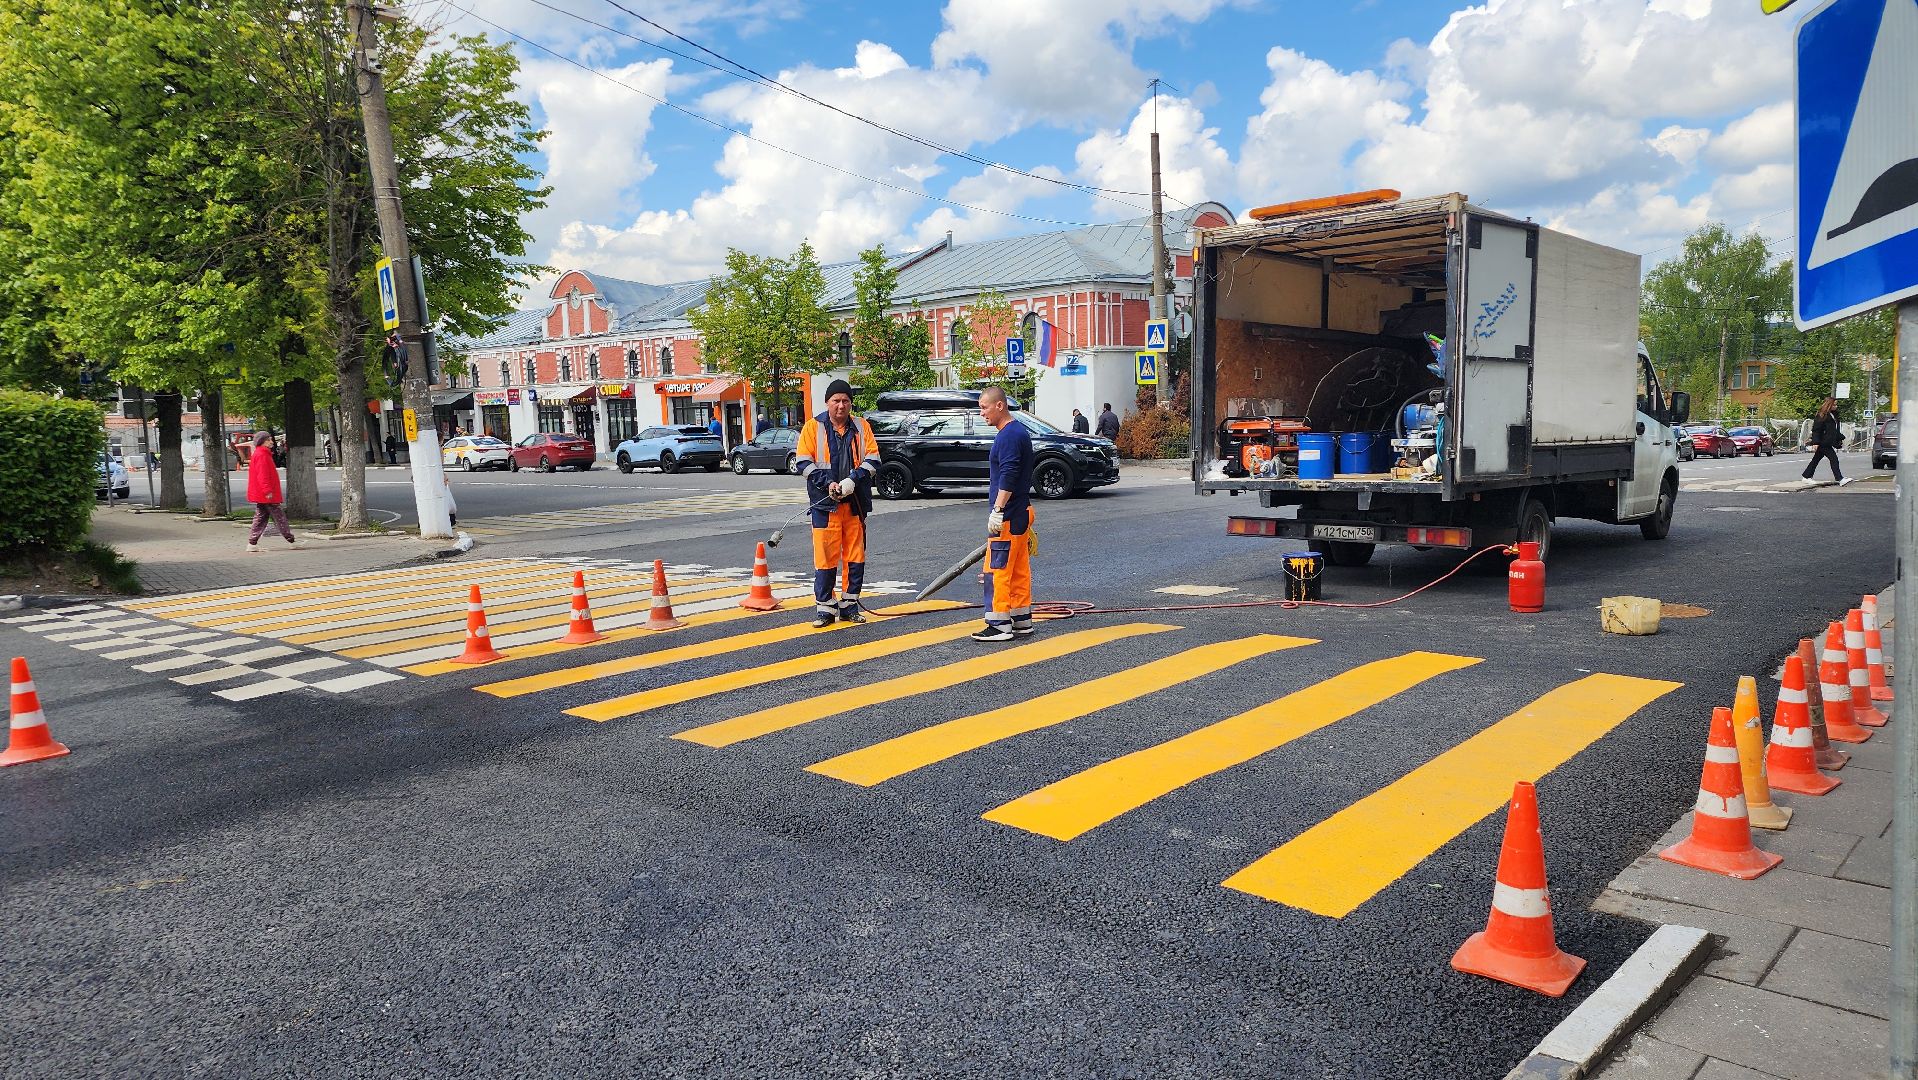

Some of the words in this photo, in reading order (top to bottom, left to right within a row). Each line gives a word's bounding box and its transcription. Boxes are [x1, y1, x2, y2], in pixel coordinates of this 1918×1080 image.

[1067, 356, 1079, 364] 72
[600, 384, 622, 396] СУШИ
[1356, 527, 1372, 536] 750
